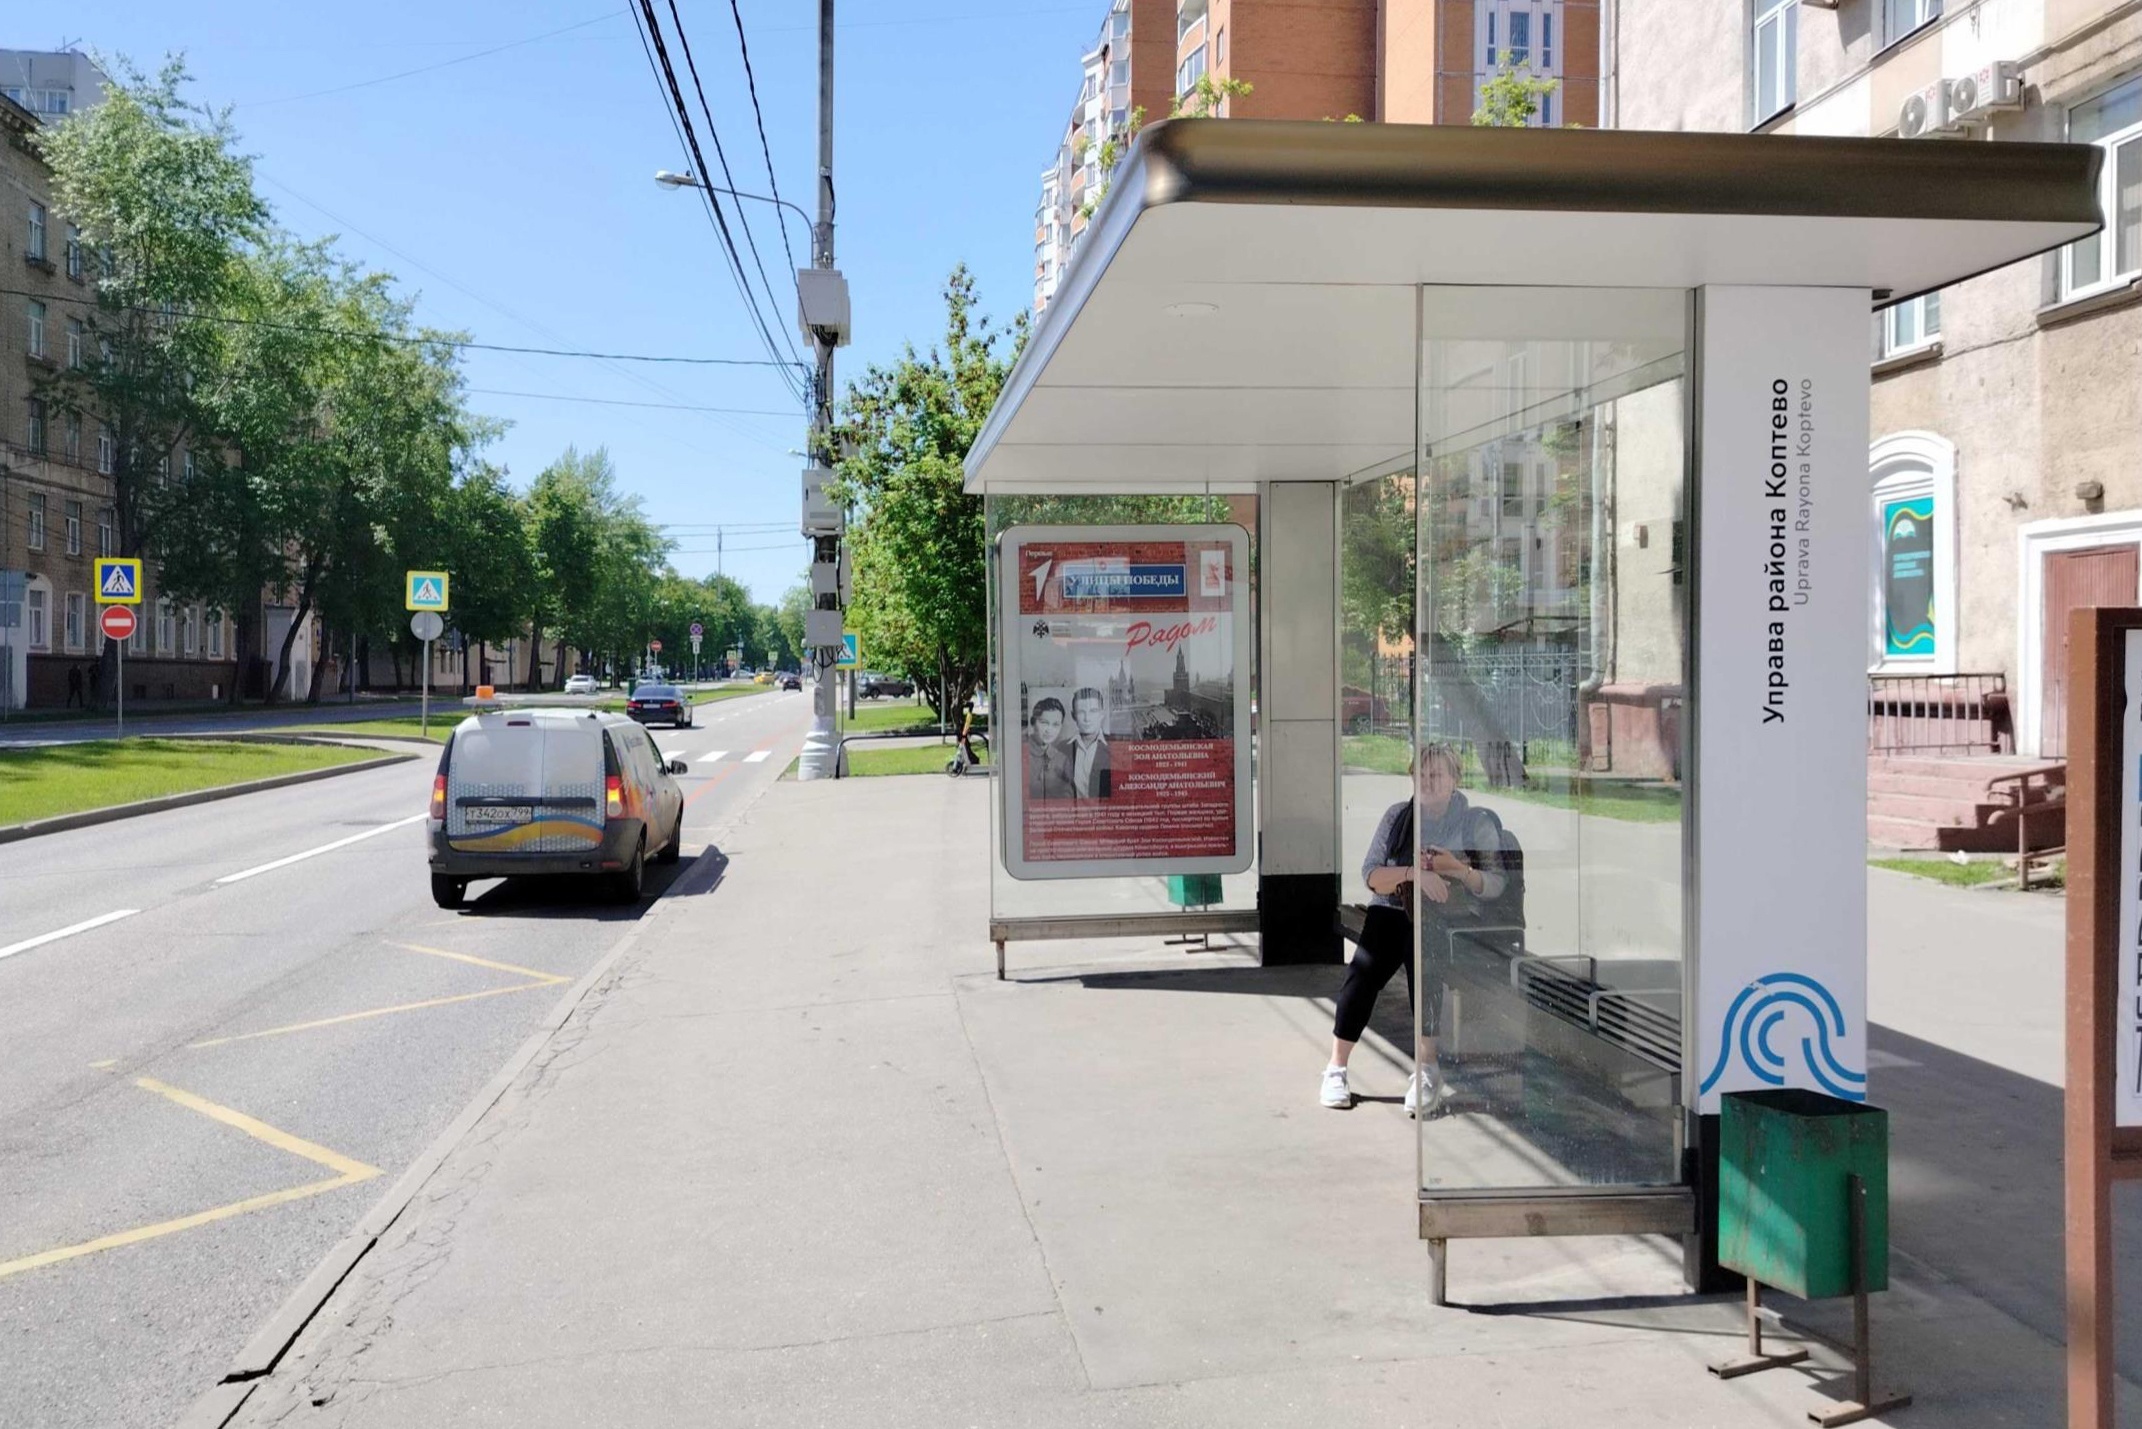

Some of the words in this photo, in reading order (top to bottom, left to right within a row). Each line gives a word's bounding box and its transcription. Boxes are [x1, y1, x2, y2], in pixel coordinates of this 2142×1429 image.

[1765, 378, 1788, 498] Коптево
[1796, 378, 1814, 457] Koptevo
[1795, 462, 1813, 532] Rayona
[1069, 574, 1121, 587] УЛИЦЫ
[1122, 574, 1180, 587] ПОБЕДЫ
[1763, 508, 1789, 613] района
[1794, 537, 1812, 606] Uprava
[1125, 616, 1218, 656] Рядом
[1763, 621, 1789, 724] Управа
